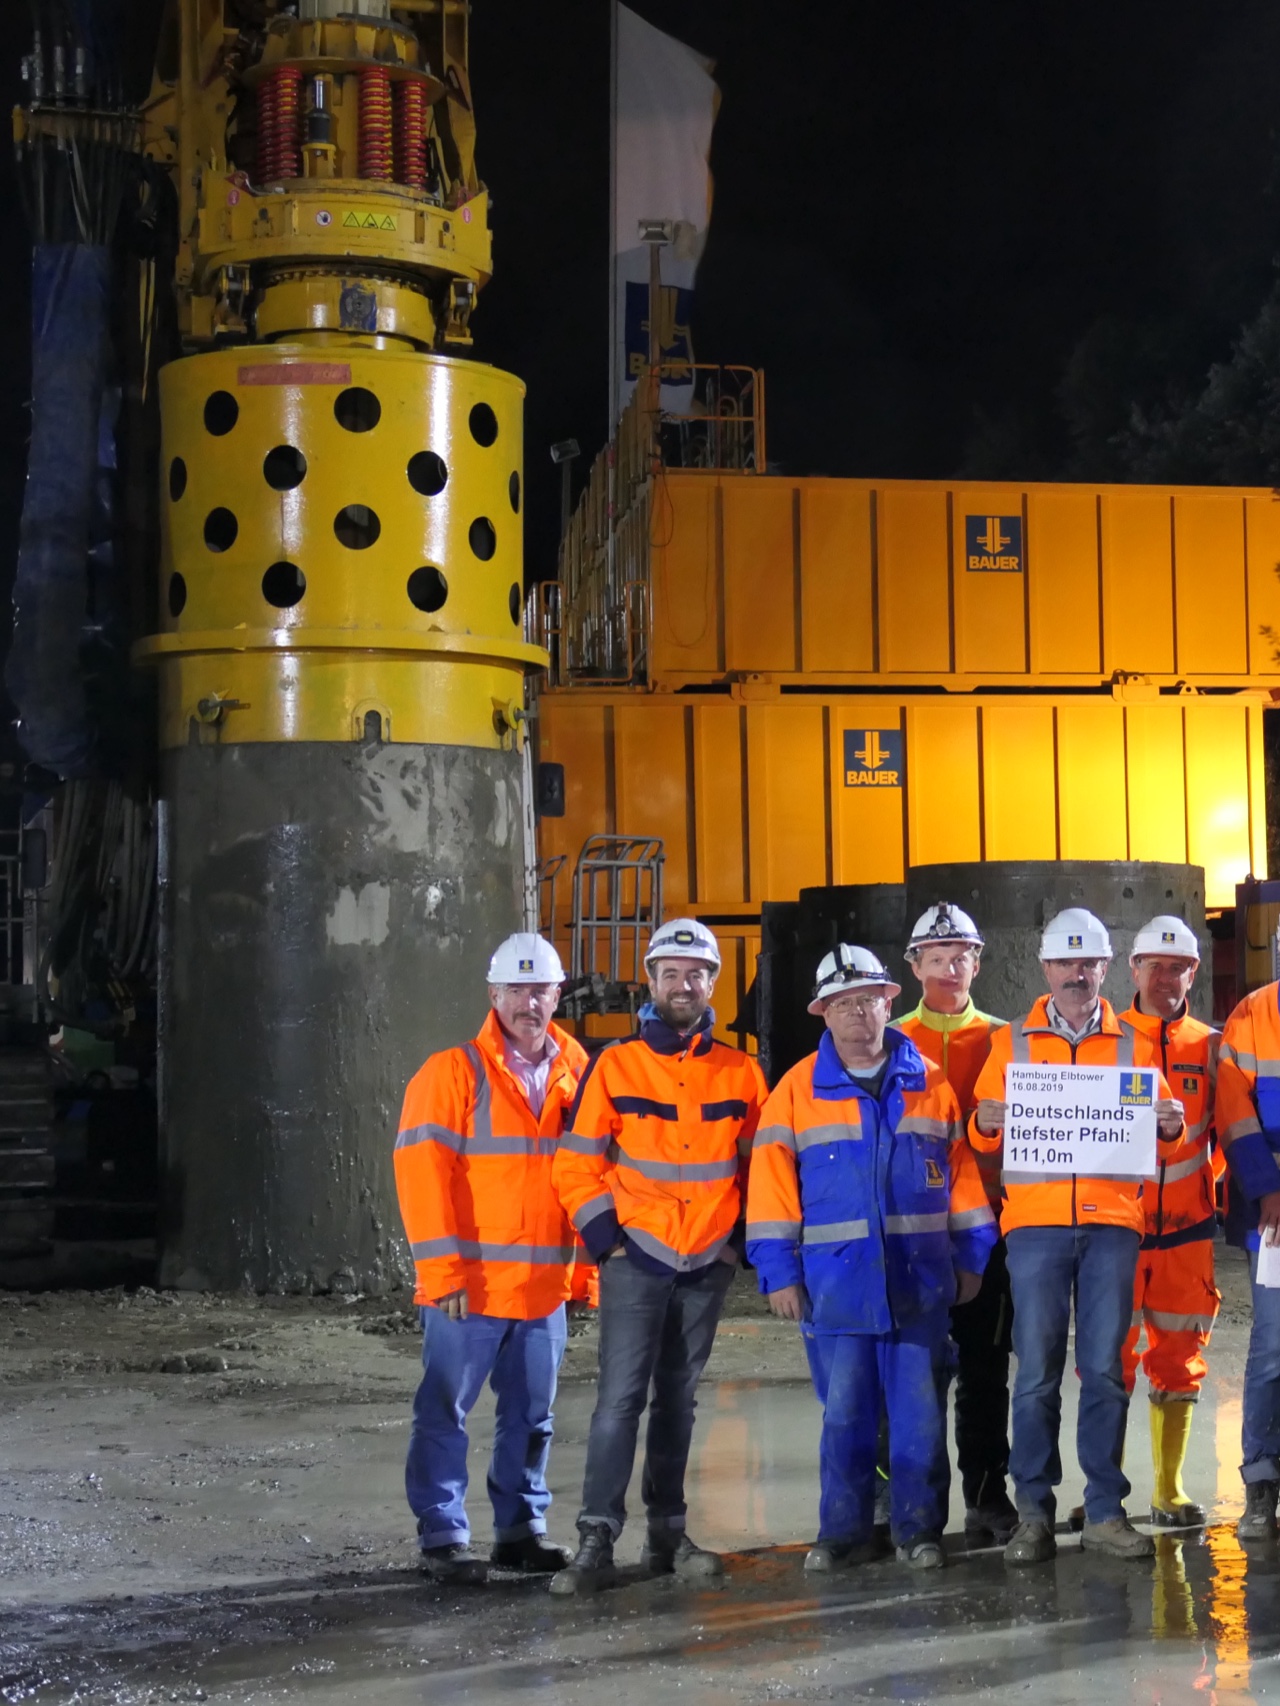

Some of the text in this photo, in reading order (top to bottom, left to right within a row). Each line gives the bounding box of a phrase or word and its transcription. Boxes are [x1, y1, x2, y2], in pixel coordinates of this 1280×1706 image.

[968, 555, 1019, 570] BAUER
[846, 770, 899, 785] BAUER
[1011, 1070, 1104, 1082] Hamburg Elbtower
[1011, 1082, 1064, 1093] 16.08.2019
[1120, 1095, 1151, 1105] BAUER
[1011, 1103, 1135, 1121] Deutschlands
[1010, 1125, 1131, 1143] tiefster Pfahl:
[1010, 1147, 1073, 1166] 111,0m
